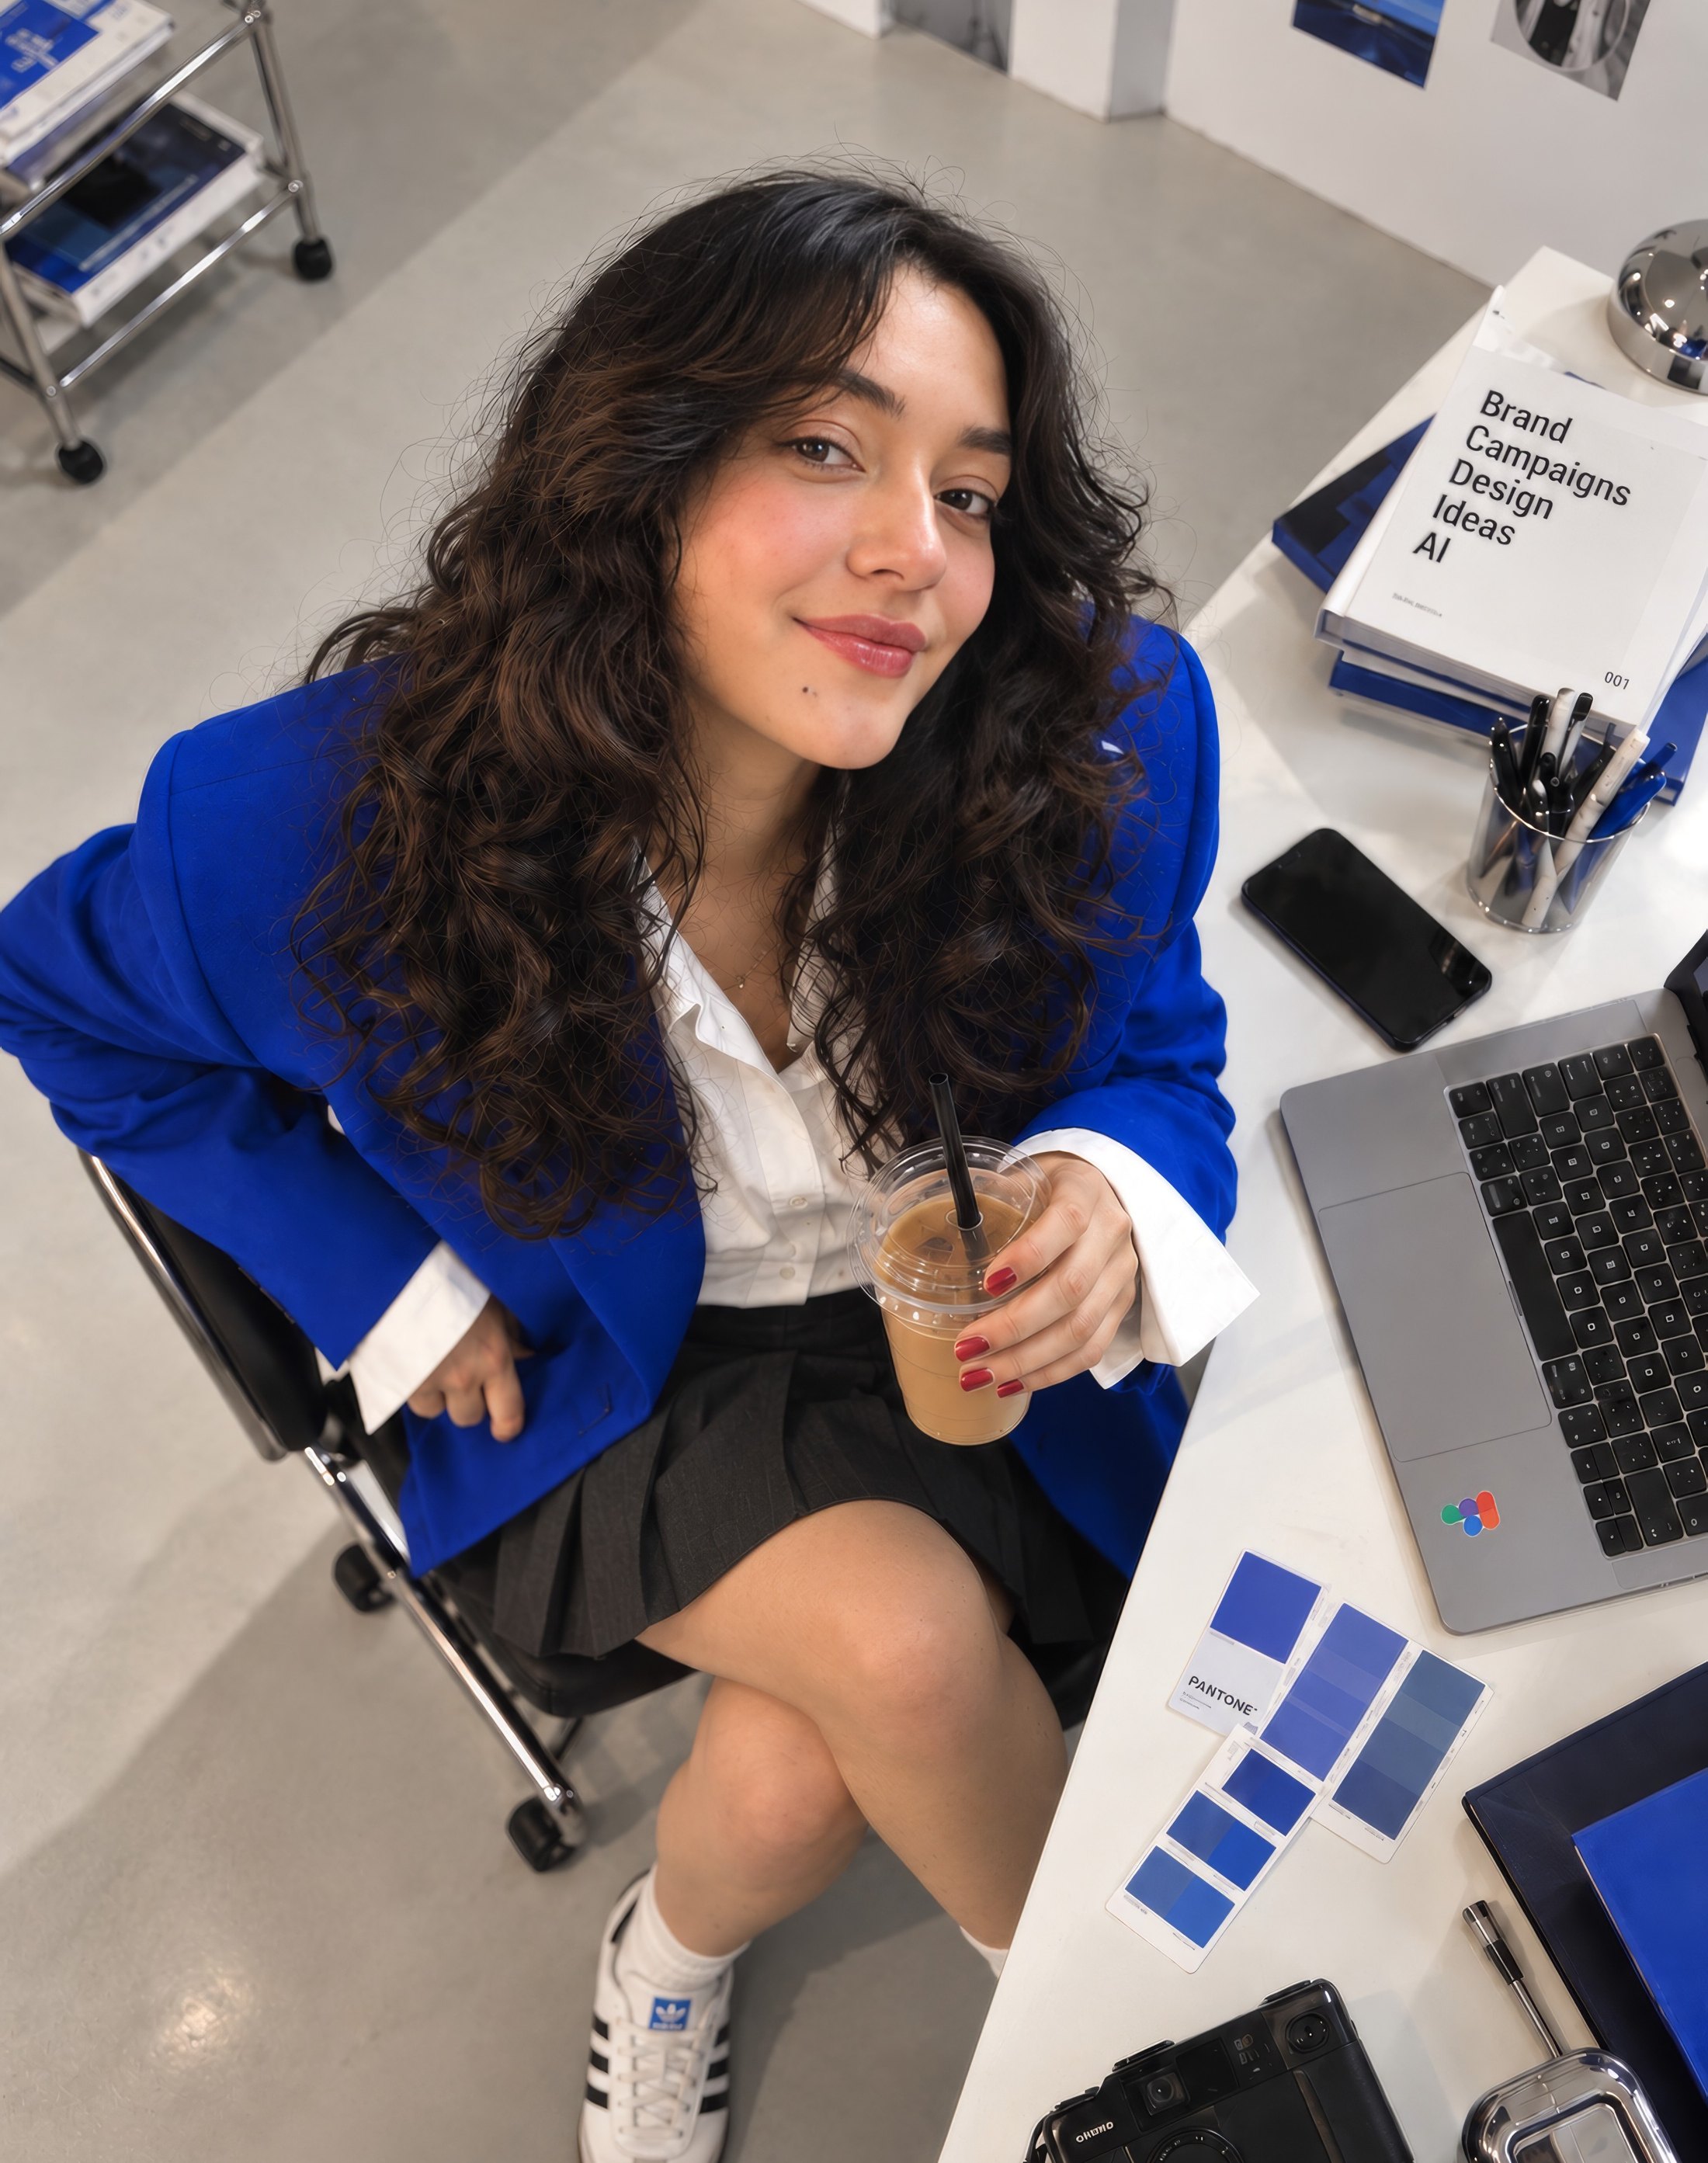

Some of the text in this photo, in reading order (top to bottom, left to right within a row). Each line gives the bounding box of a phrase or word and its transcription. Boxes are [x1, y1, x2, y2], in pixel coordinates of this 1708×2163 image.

[1480, 389, 1573, 444] Brand
[1449, 458, 1554, 520] Design
[1466, 425, 1631, 507] Campaigns
[1432, 494, 1516, 546] Ideas
[1411, 531, 1451, 564] AI
[1604, 672, 1630, 690] 001
[1188, 1675, 1254, 1716] PANTONE
